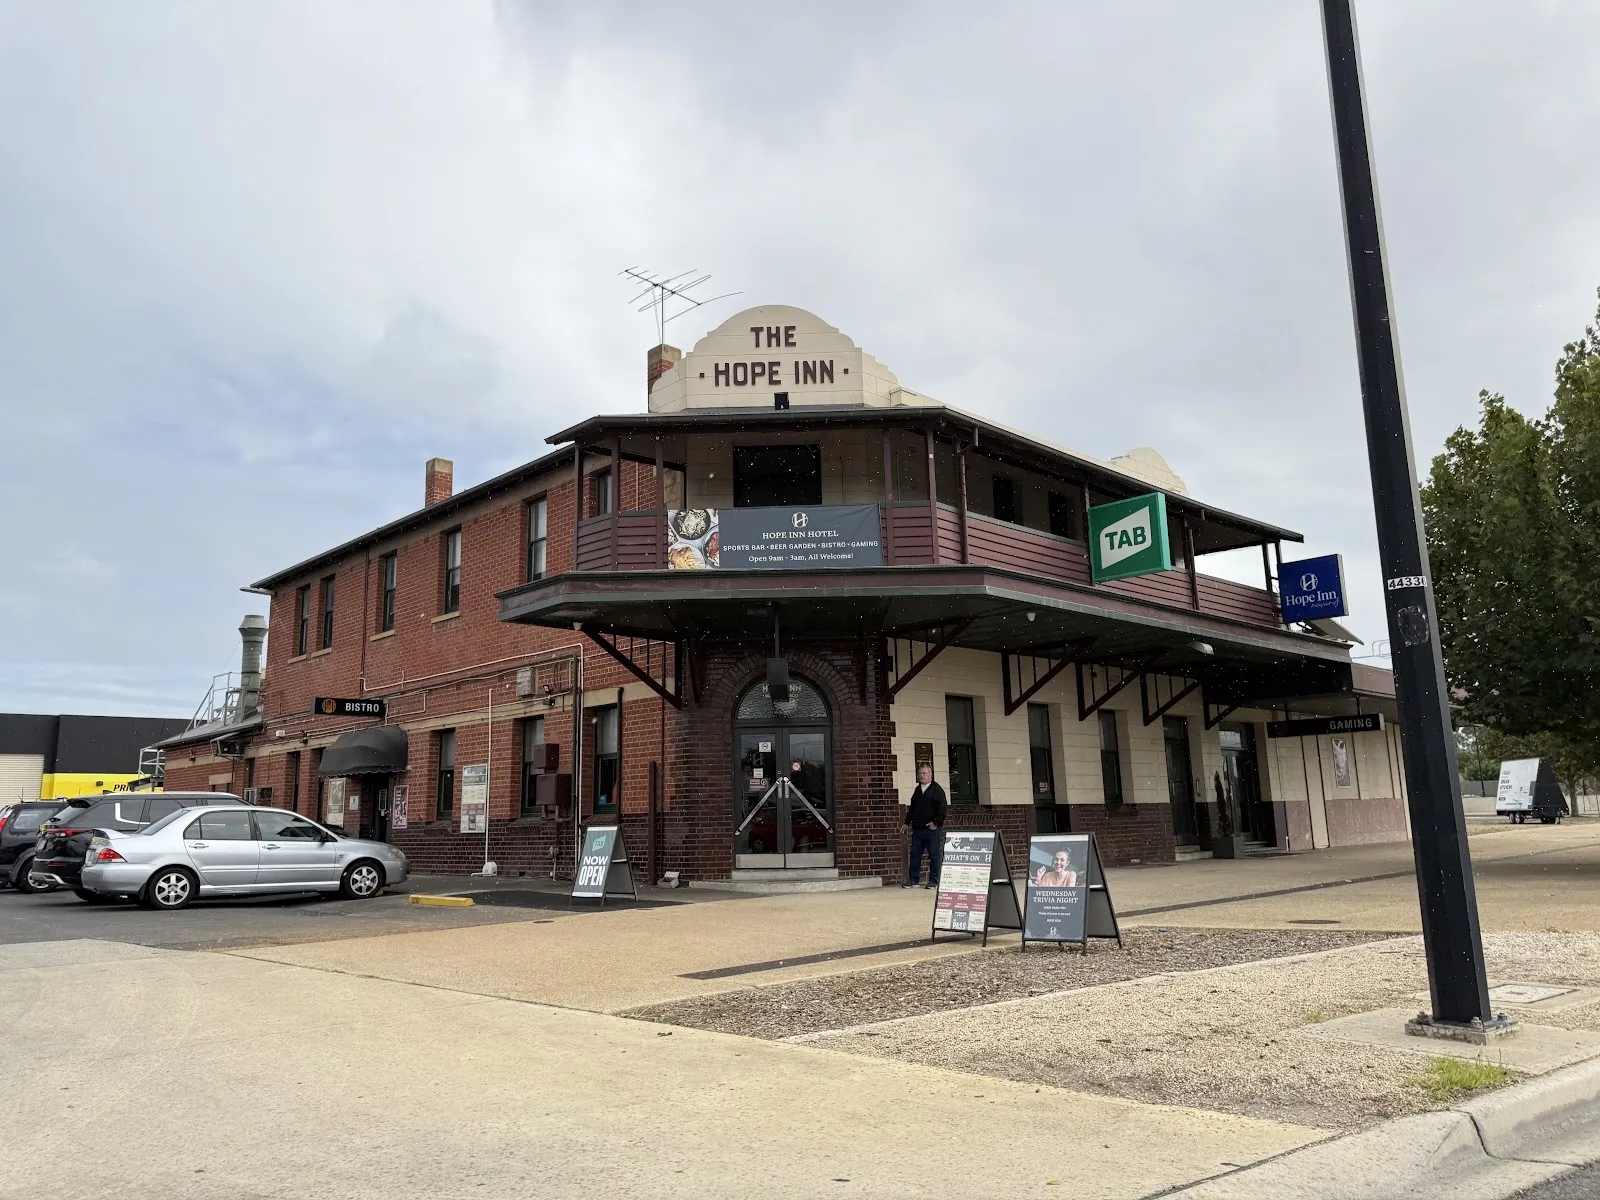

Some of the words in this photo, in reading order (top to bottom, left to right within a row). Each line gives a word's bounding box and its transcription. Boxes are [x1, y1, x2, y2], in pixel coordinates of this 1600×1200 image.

[750, 325, 797, 348] THE
[714, 361, 782, 387] HOPE
[794, 359, 835, 385] INN
[762, 531, 787, 539] HOPE
[789, 531, 806, 539] INN
[807, 530, 839, 538] HOTEL
[1104, 525, 1147, 551] TAB
[788, 542, 817, 550] GARDEN
[821, 541, 846, 549] BISTRO
[851, 540, 879, 548] GAMING
[748, 555, 767, 563] Open
[819, 552, 854, 560] Welcome!
[1285, 593, 1316, 607] Hope
[1316, 590, 1337, 602] Inn
[345, 702, 380, 713] BISTRO
[1329, 718, 1373, 730] GAMING
[583, 855, 609, 865] NOW
[578, 865, 606, 886] OPEN
[952, 921, 967, 930] PASS
